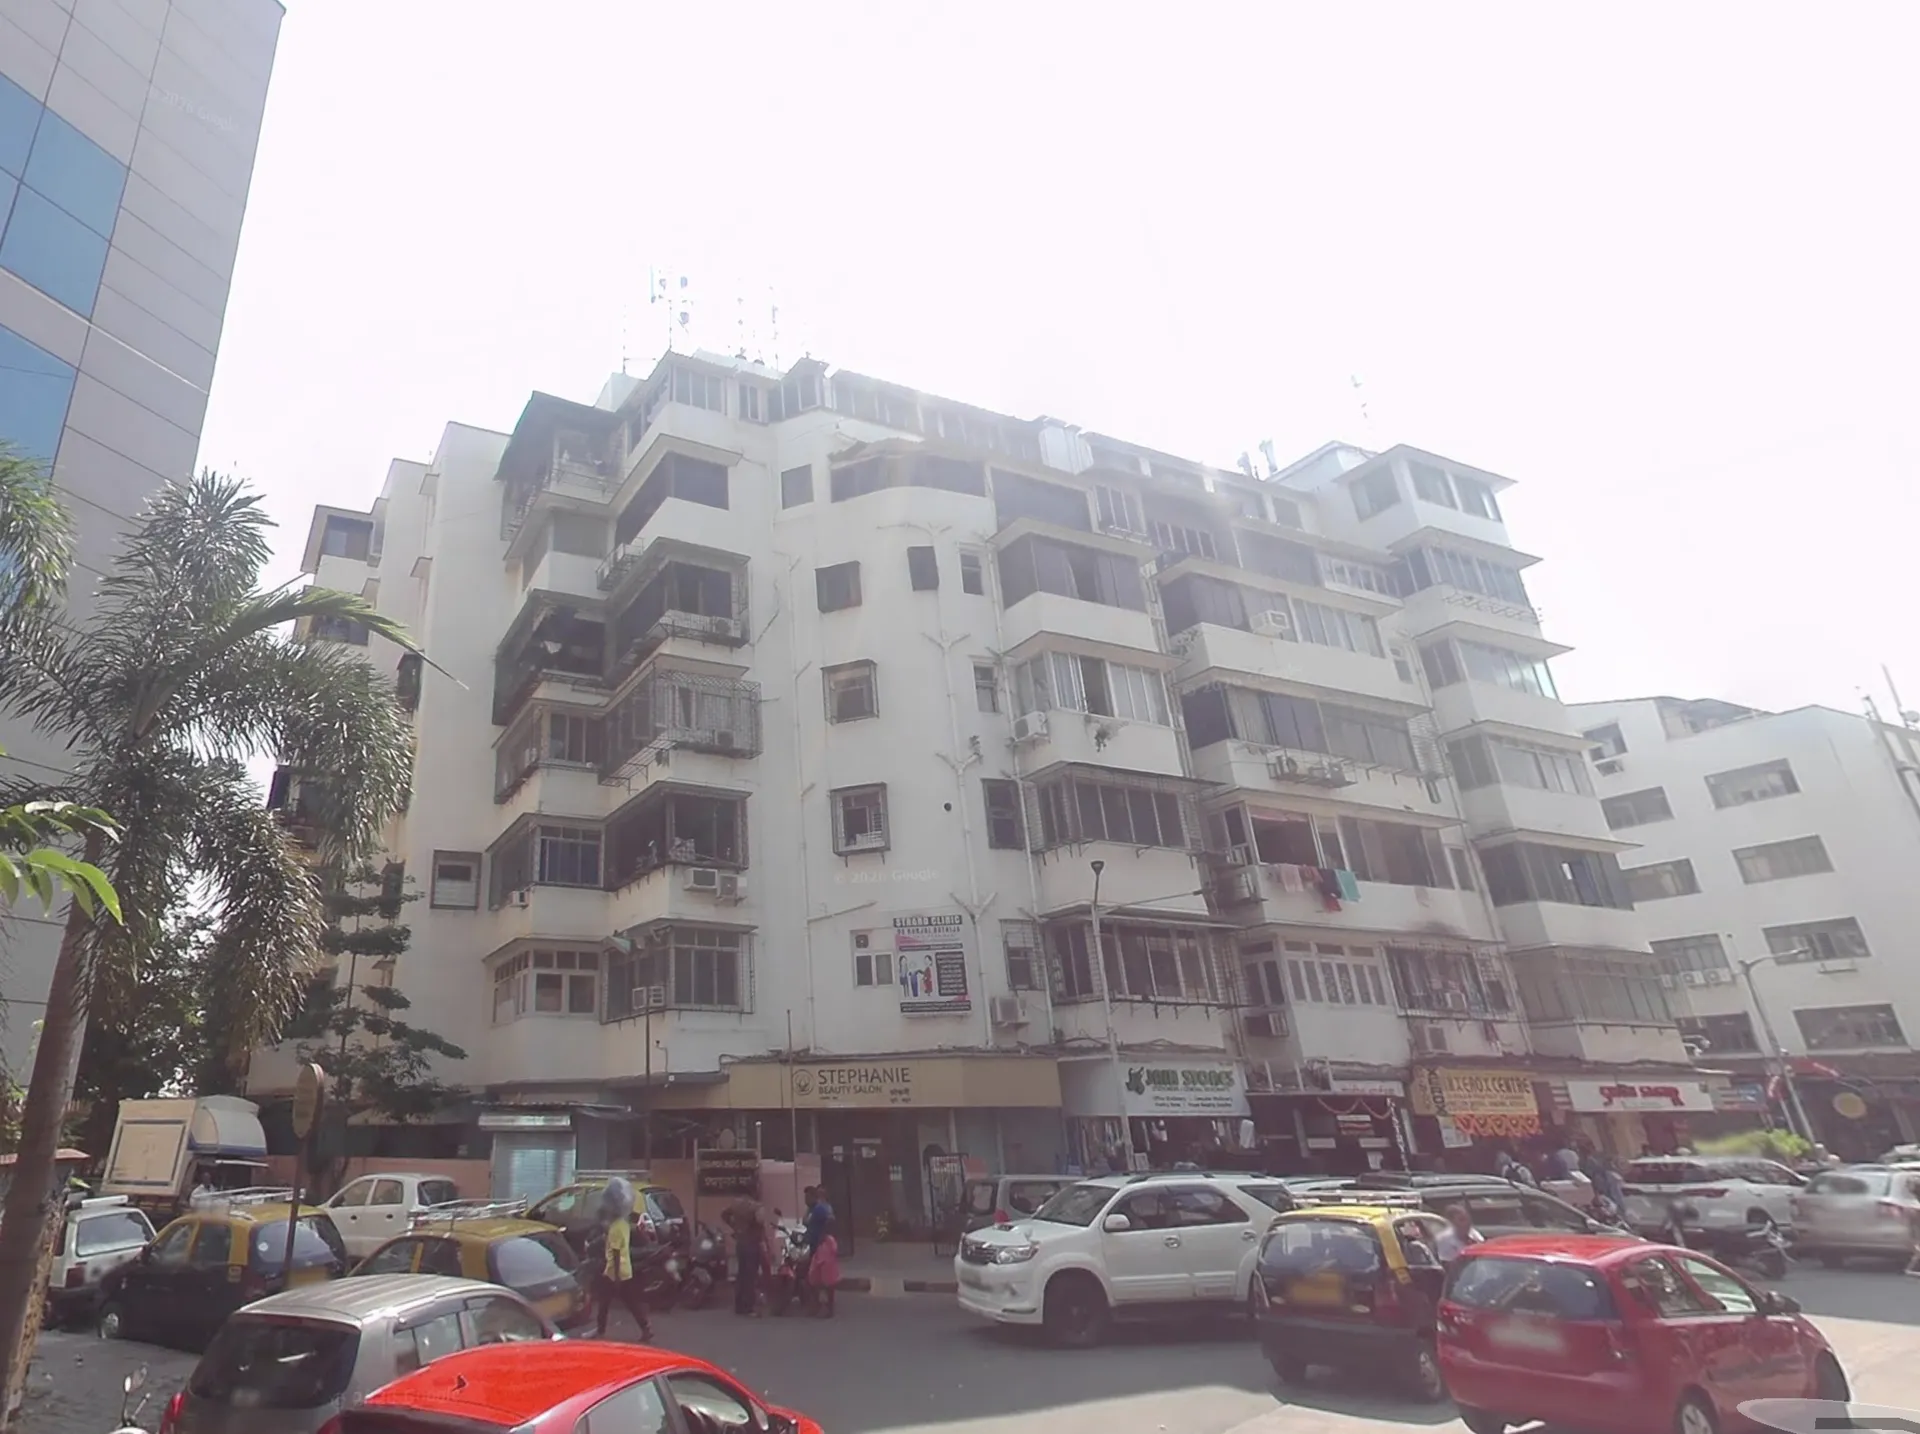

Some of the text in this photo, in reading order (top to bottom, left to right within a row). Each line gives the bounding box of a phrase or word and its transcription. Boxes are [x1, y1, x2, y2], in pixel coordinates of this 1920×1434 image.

[896, 915, 961, 927] STRAND CLINIC
[818, 1067, 911, 1084] STEPHANIE
[818, 1084, 883, 1095] BEAUTY SALON
[1427, 1067, 1448, 1117] XEROX
[1490, 1076, 1531, 1094] CENTRE
